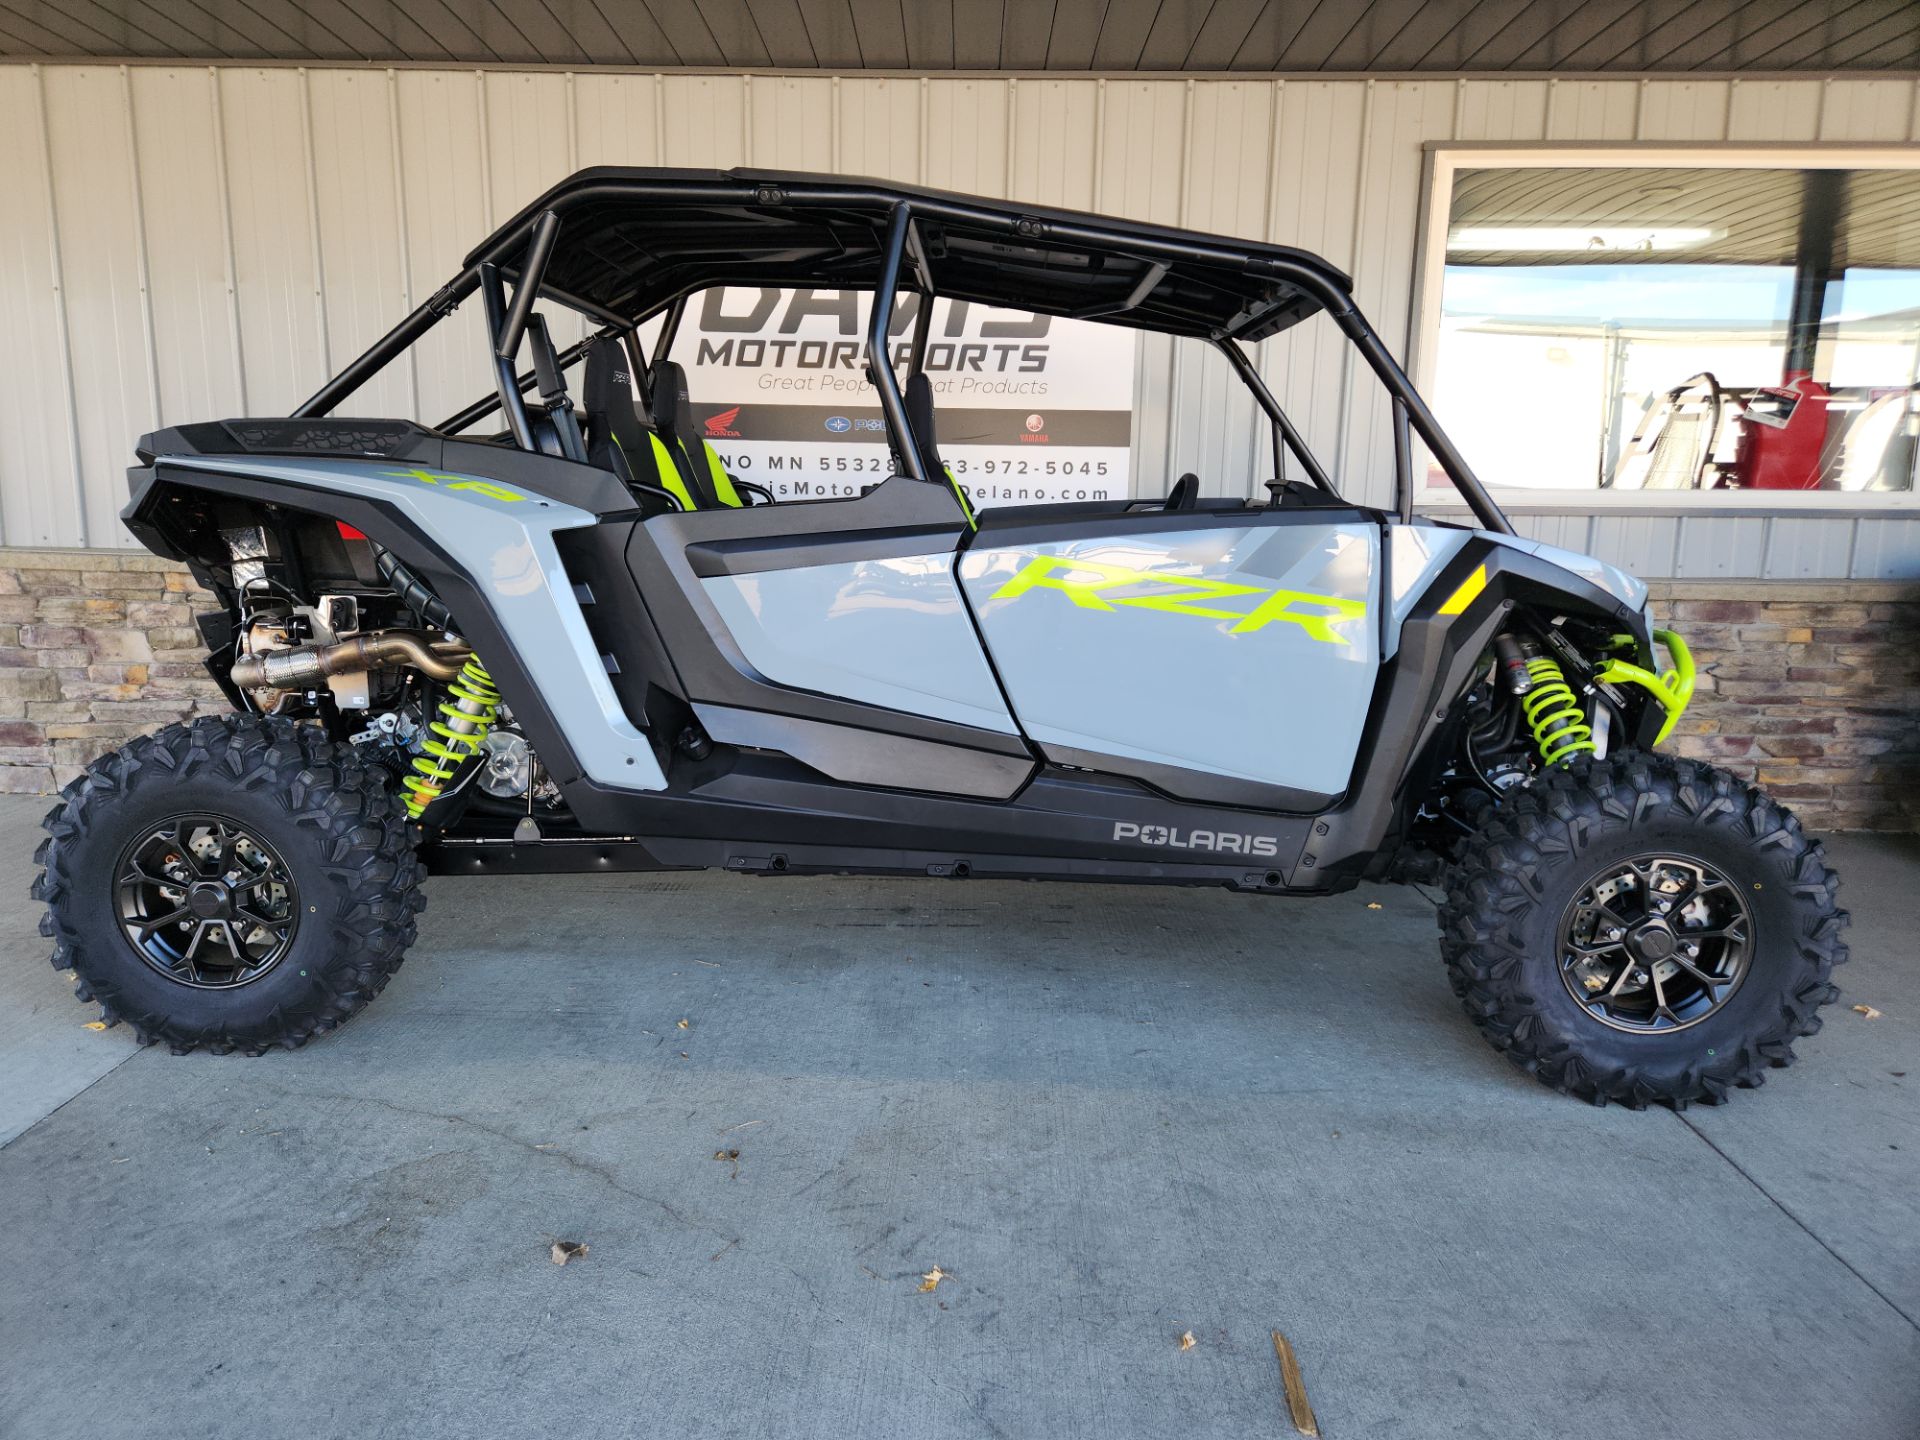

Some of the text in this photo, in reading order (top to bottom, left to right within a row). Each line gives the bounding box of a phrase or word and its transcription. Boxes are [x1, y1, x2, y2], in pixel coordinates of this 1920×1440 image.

[758, 373, 814, 390] Great
[820, 375, 877, 396] Peop
[960, 377, 1048, 395] Products
[854, 418, 886, 430] POL
[1019, 434, 1049, 443] YAMAHA
[718, 454, 1108, 476] NO MN 55328 63-972-5045
[376, 468, 528, 503] XP
[989, 555, 1367, 645] RZR
[1113, 822, 1278, 857] POLARIS
